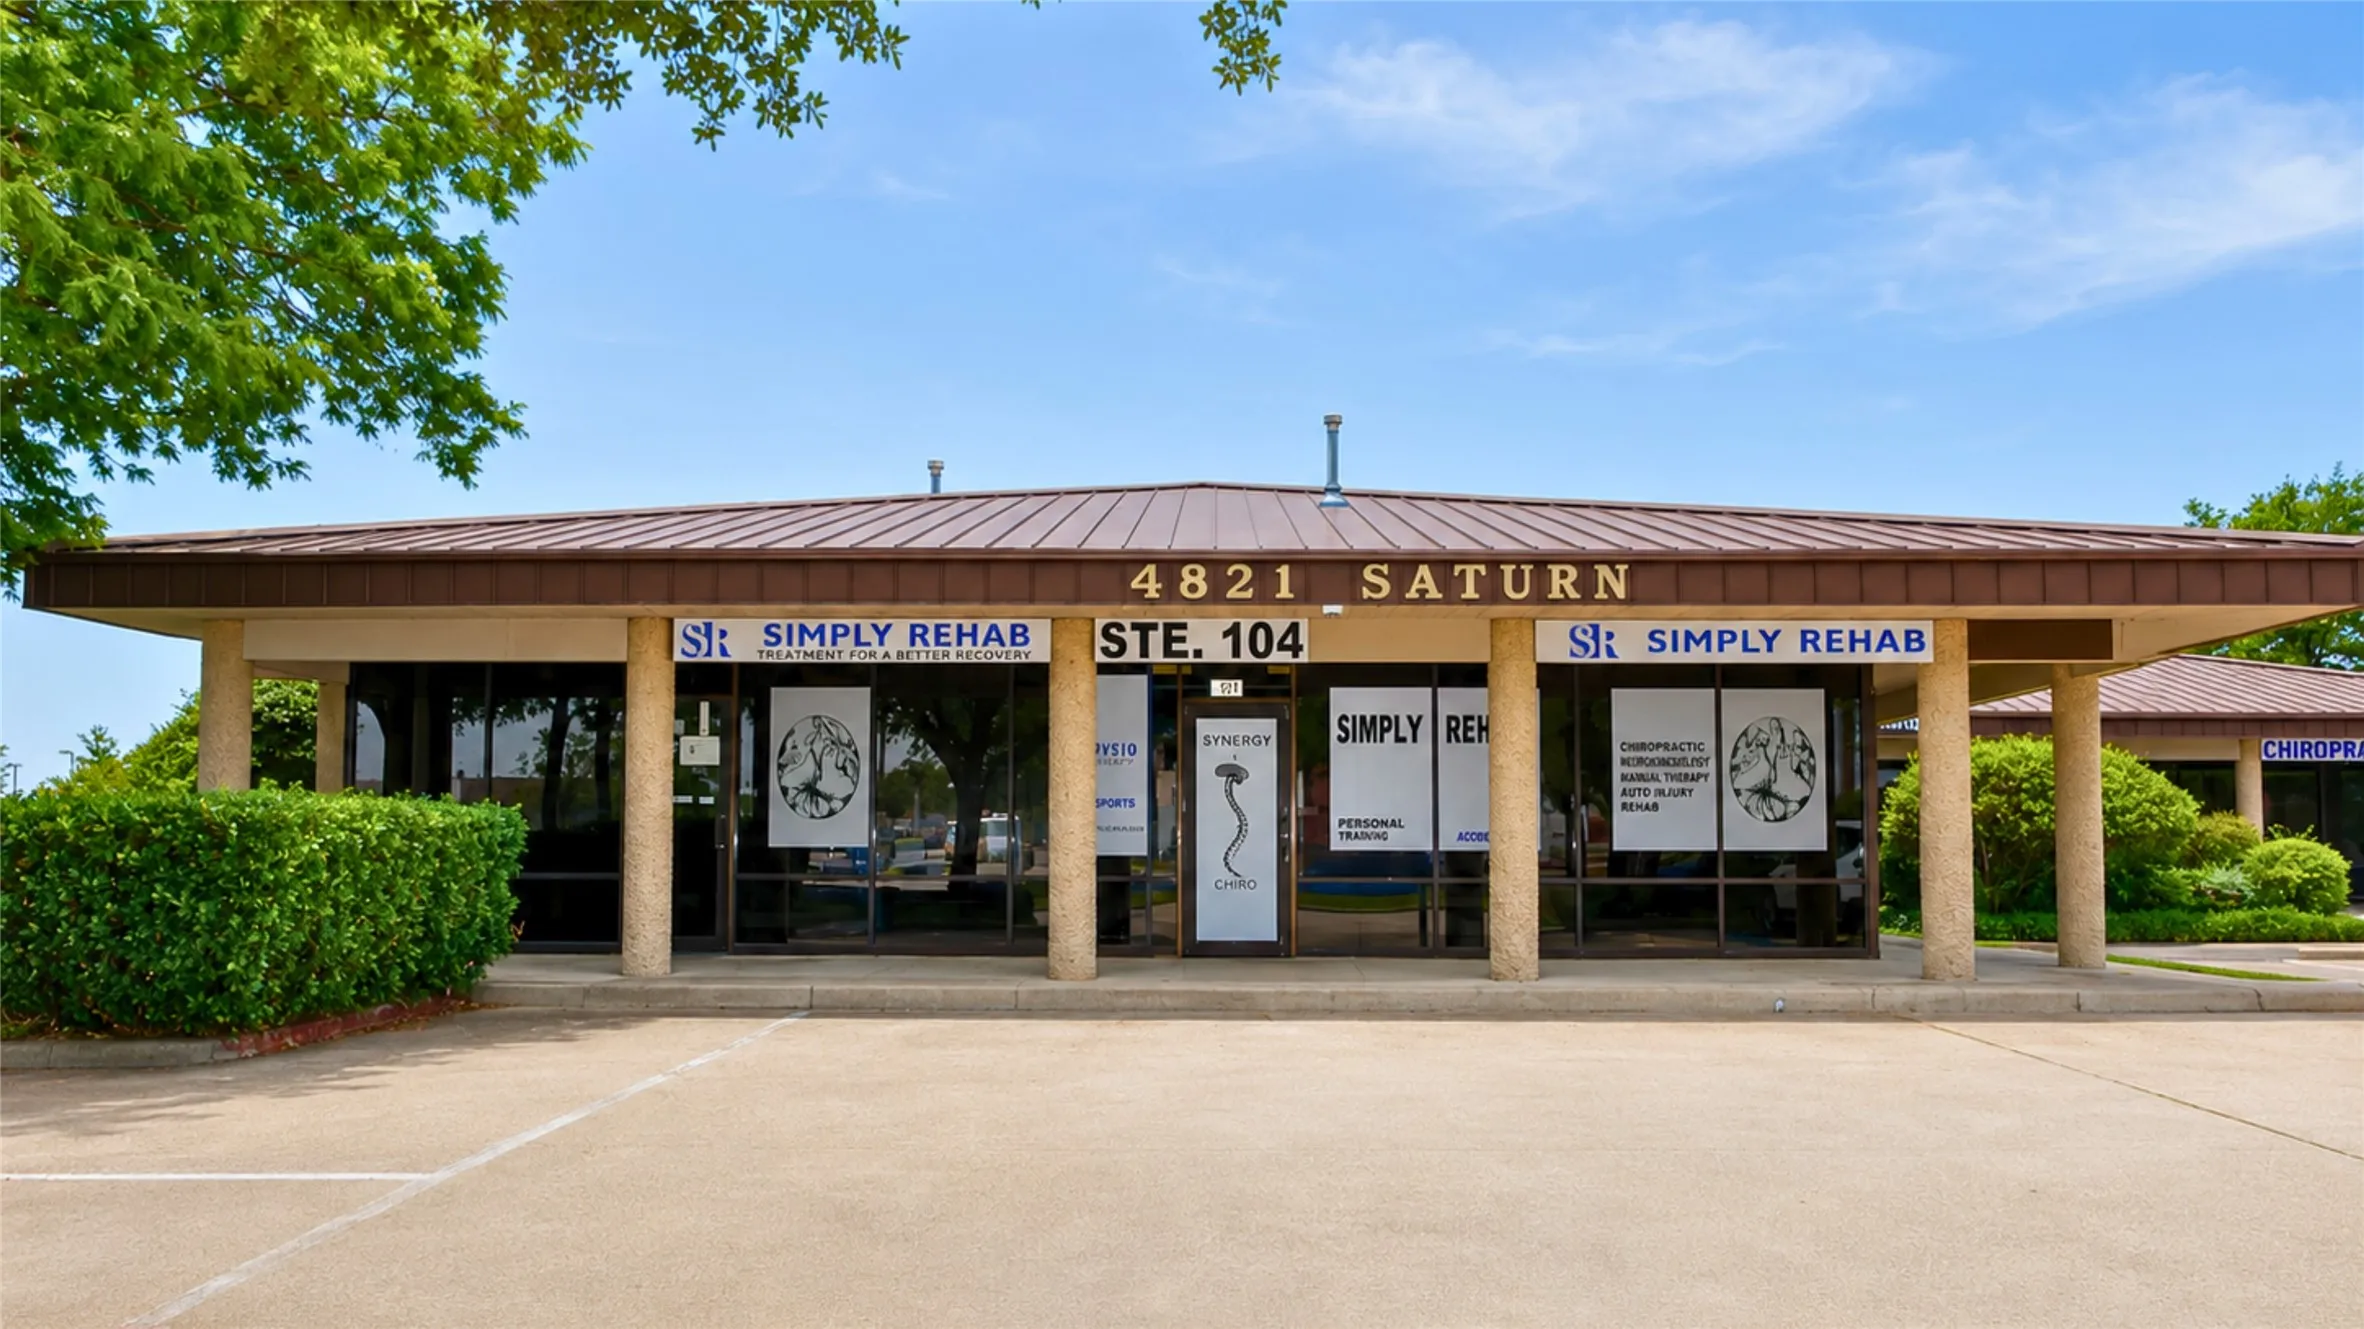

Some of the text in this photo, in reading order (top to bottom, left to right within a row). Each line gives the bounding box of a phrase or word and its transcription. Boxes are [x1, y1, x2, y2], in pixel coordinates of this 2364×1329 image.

[1130, 563, 1630, 601] 4821 SATURN
[680, 621, 732, 659] SR
[763, 622, 1031, 648] SIMPLY REHAB
[1099, 621, 1305, 660] STE. 104
[1568, 623, 1620, 659] SR
[1647, 629, 1927, 654] SIMPLY REHAB
[757, 649, 1032, 661] TREATMENT FOR A BETTER RECOVERY
[1336, 713, 1424, 744] SIMPLY
[1202, 734, 1272, 747] SYNERGY
[1620, 741, 1706, 753] CHIROPRACTIC
[1620, 787, 1652, 798] AUTO
[1095, 797, 1136, 809] SPORTS
[1620, 801, 1660, 813] REHAB
[1337, 818, 1405, 829] PERSONAL
[1214, 879, 1258, 891] CHIRO
